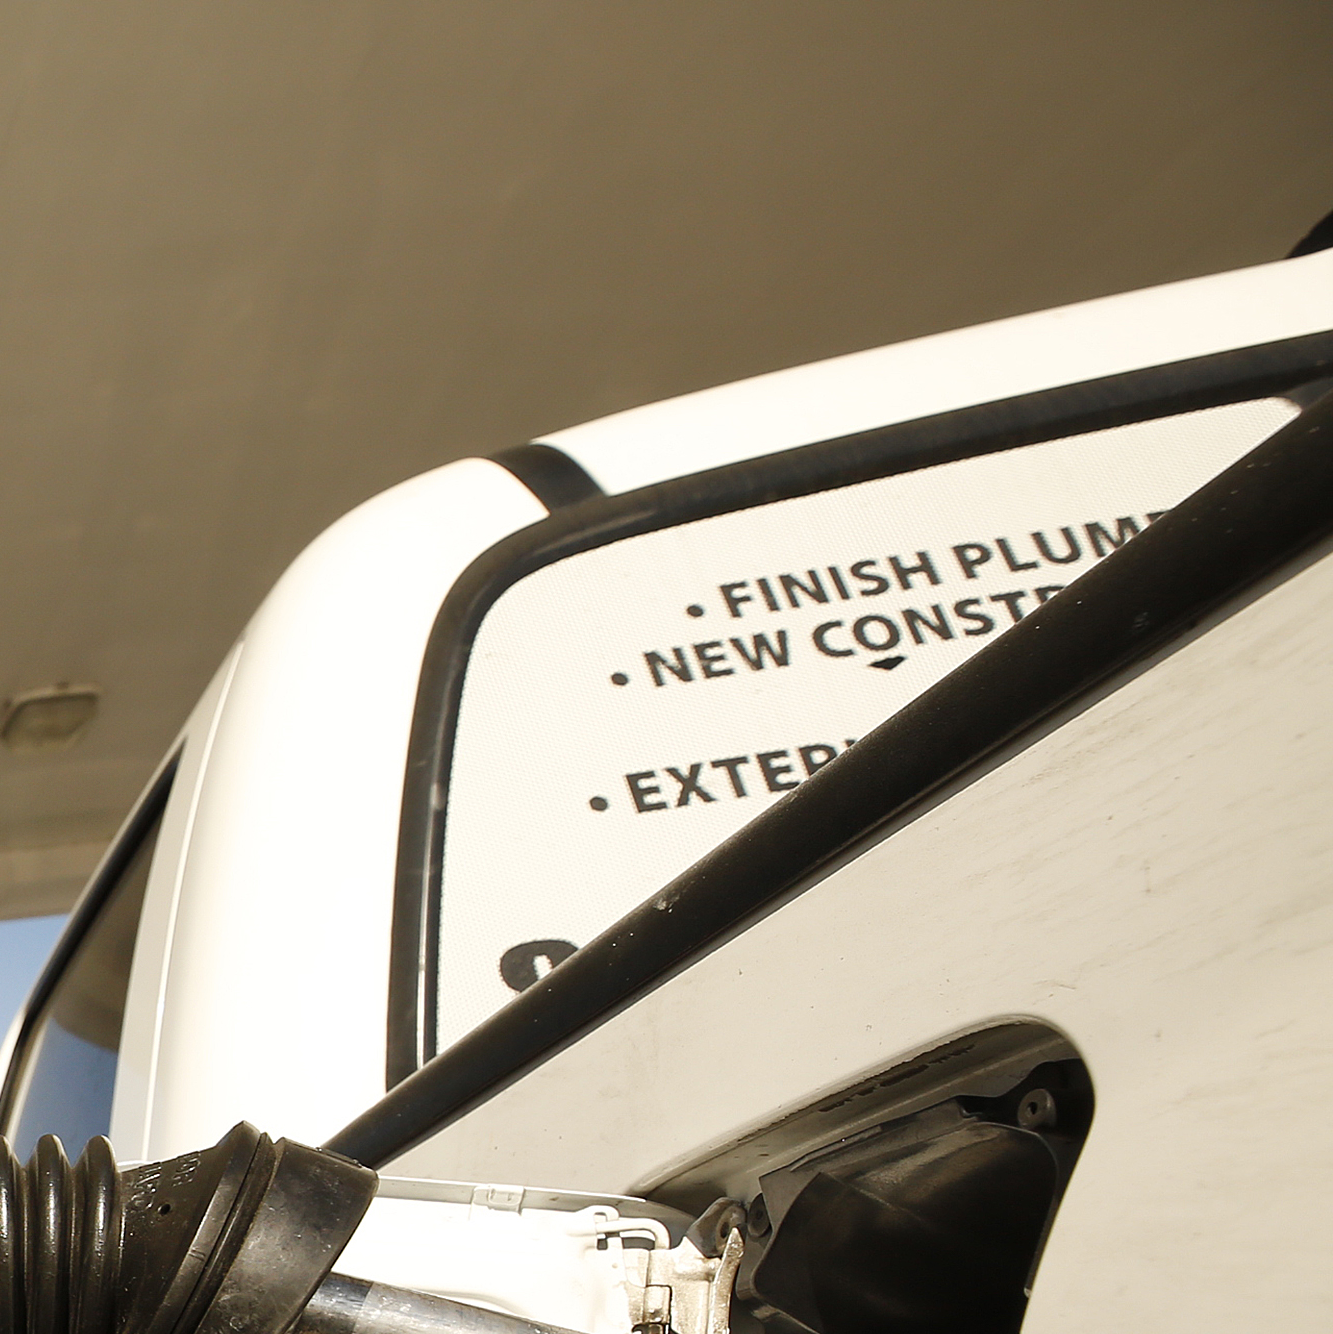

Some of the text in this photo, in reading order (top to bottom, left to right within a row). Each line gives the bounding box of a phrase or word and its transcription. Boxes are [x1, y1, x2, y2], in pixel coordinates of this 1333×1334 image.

[719, 509, 1173, 618] FINISH PLUM
[644, 629, 790, 688] NEW
